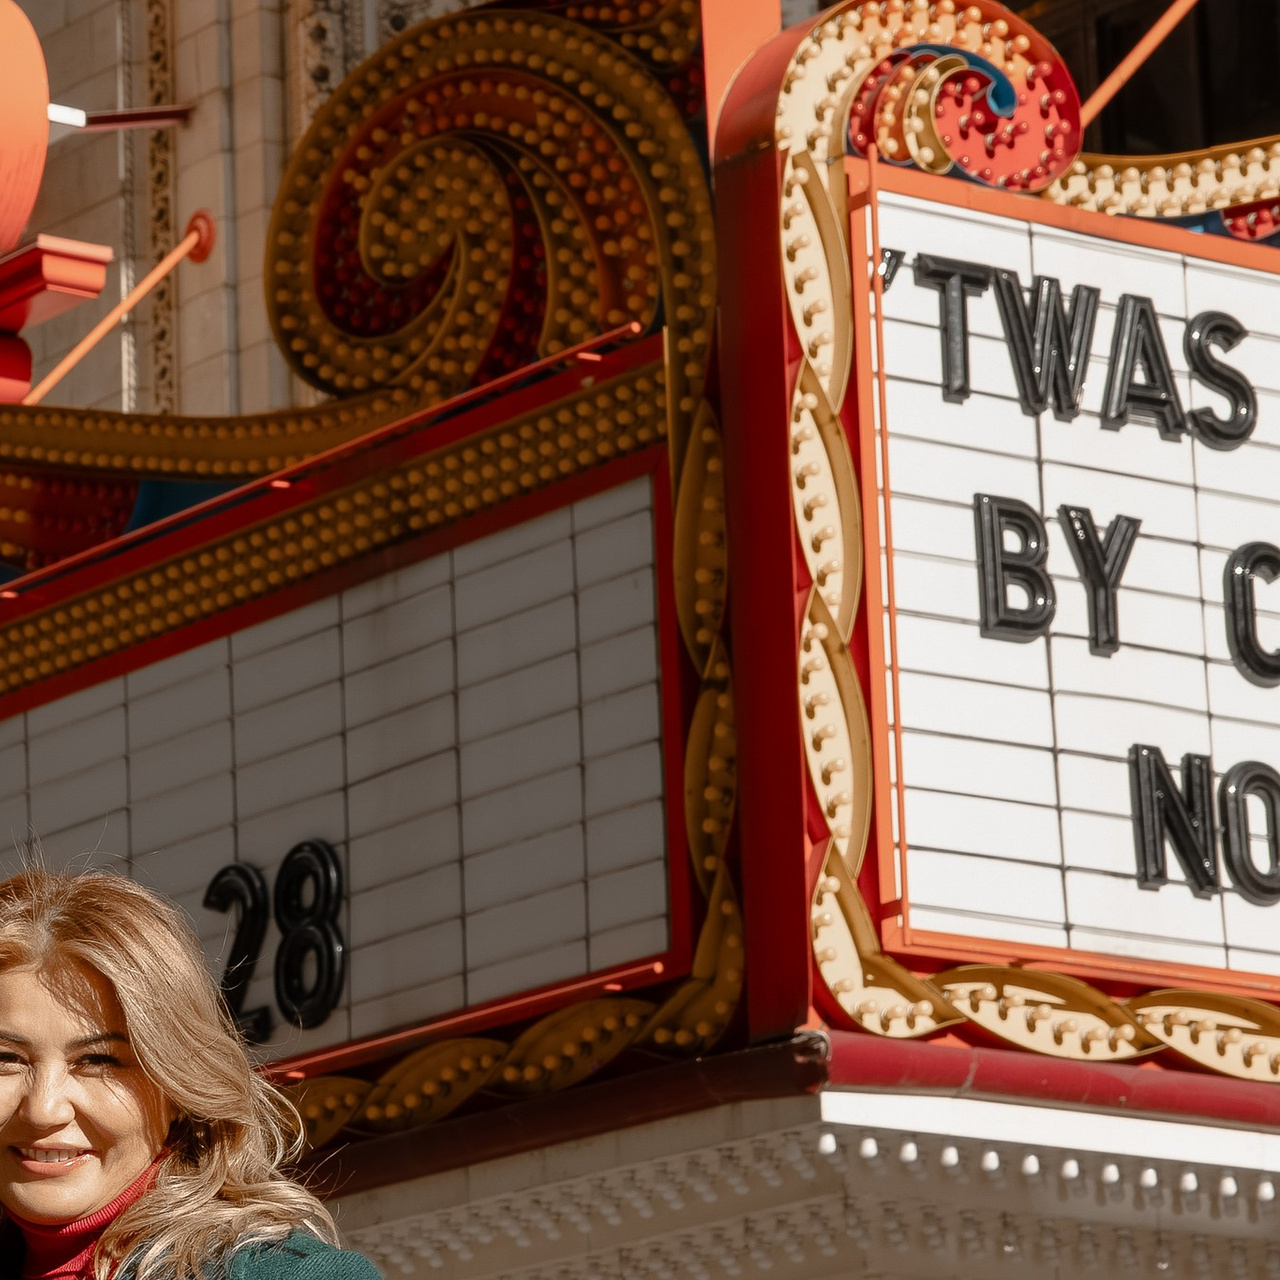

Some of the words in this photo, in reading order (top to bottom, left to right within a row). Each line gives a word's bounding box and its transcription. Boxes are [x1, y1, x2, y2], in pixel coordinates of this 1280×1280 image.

[878, 247, 1258, 453] 'TWAS
[973, 492, 1143, 658] BY
[1128, 743, 1280, 908] NO
[203, 838, 345, 1046] 28
